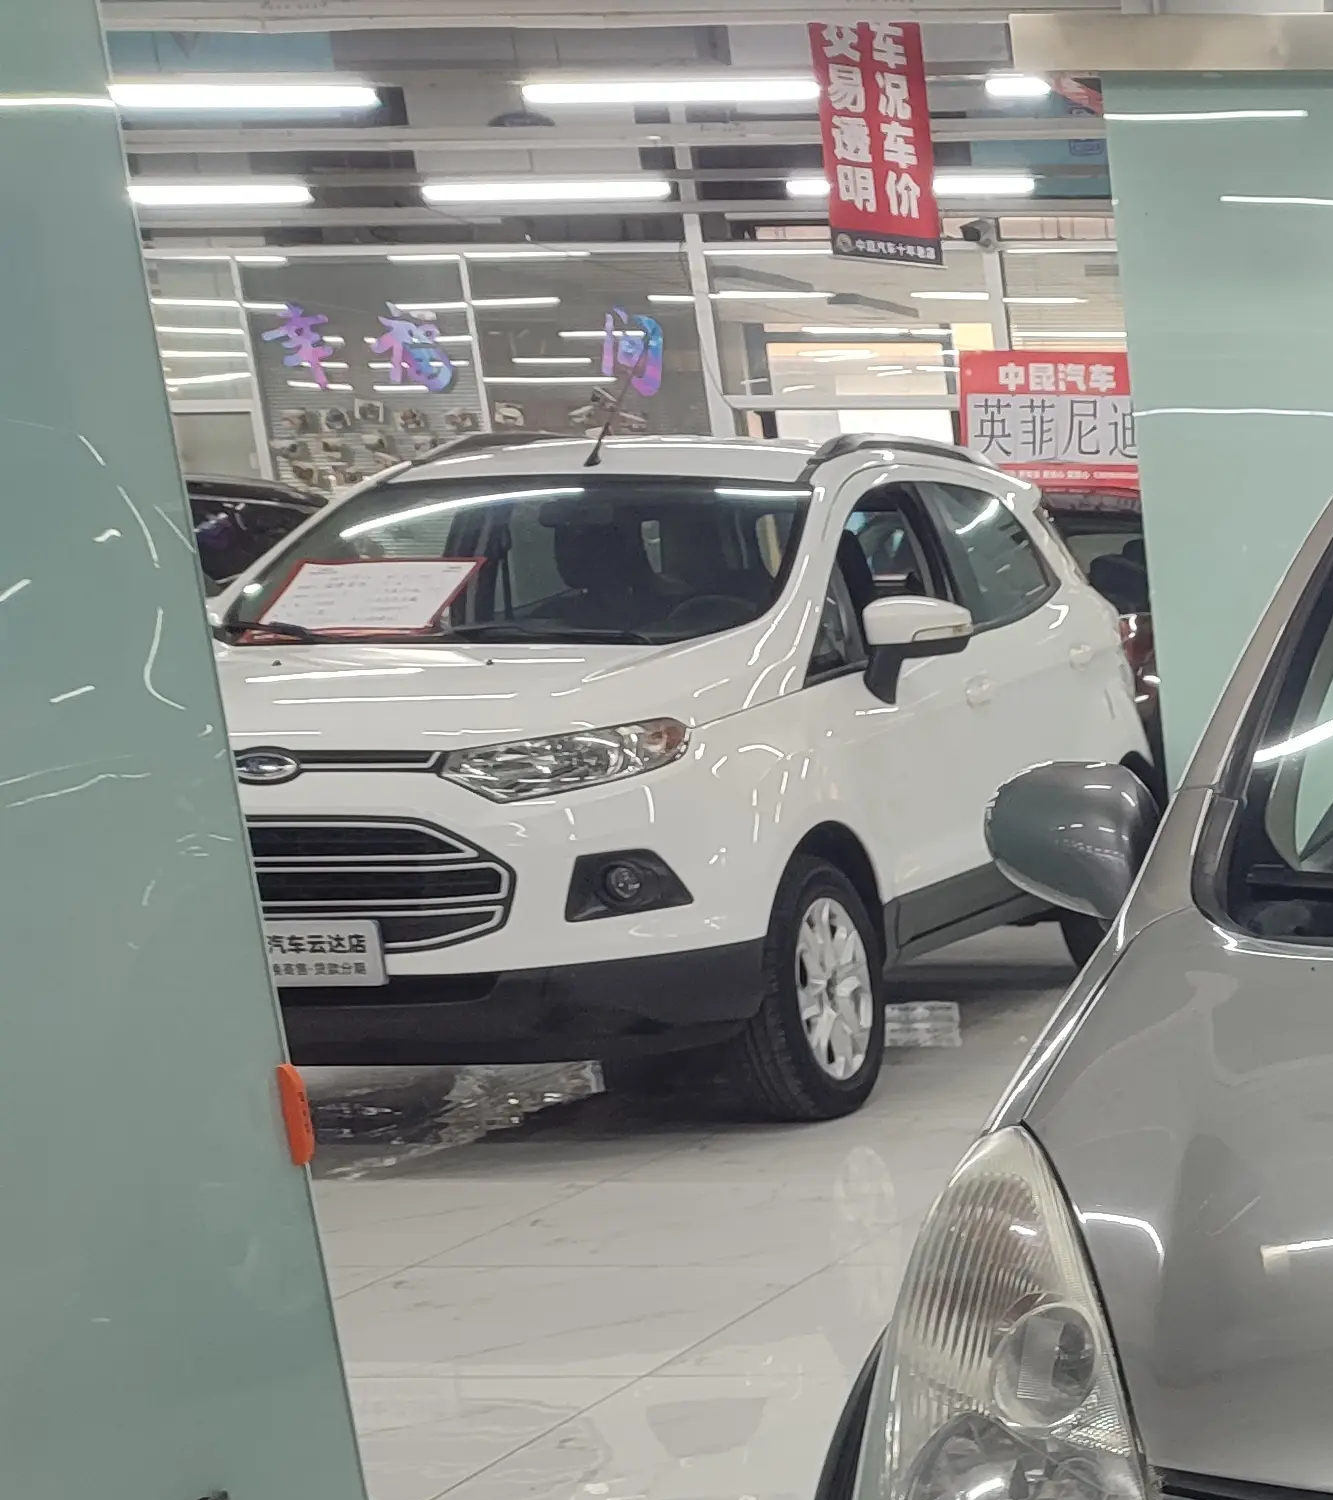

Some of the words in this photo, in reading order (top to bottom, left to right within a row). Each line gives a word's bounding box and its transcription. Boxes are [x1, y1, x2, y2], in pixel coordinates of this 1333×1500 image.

[821, 23, 878, 213] 交易透明
[869, 22, 921, 219] 车况车价
[998, 361, 1117, 393] 中昆汽车
[973, 398, 1139, 460] 英菲尼迪
[266, 933, 367, 954] 汽车云达店
